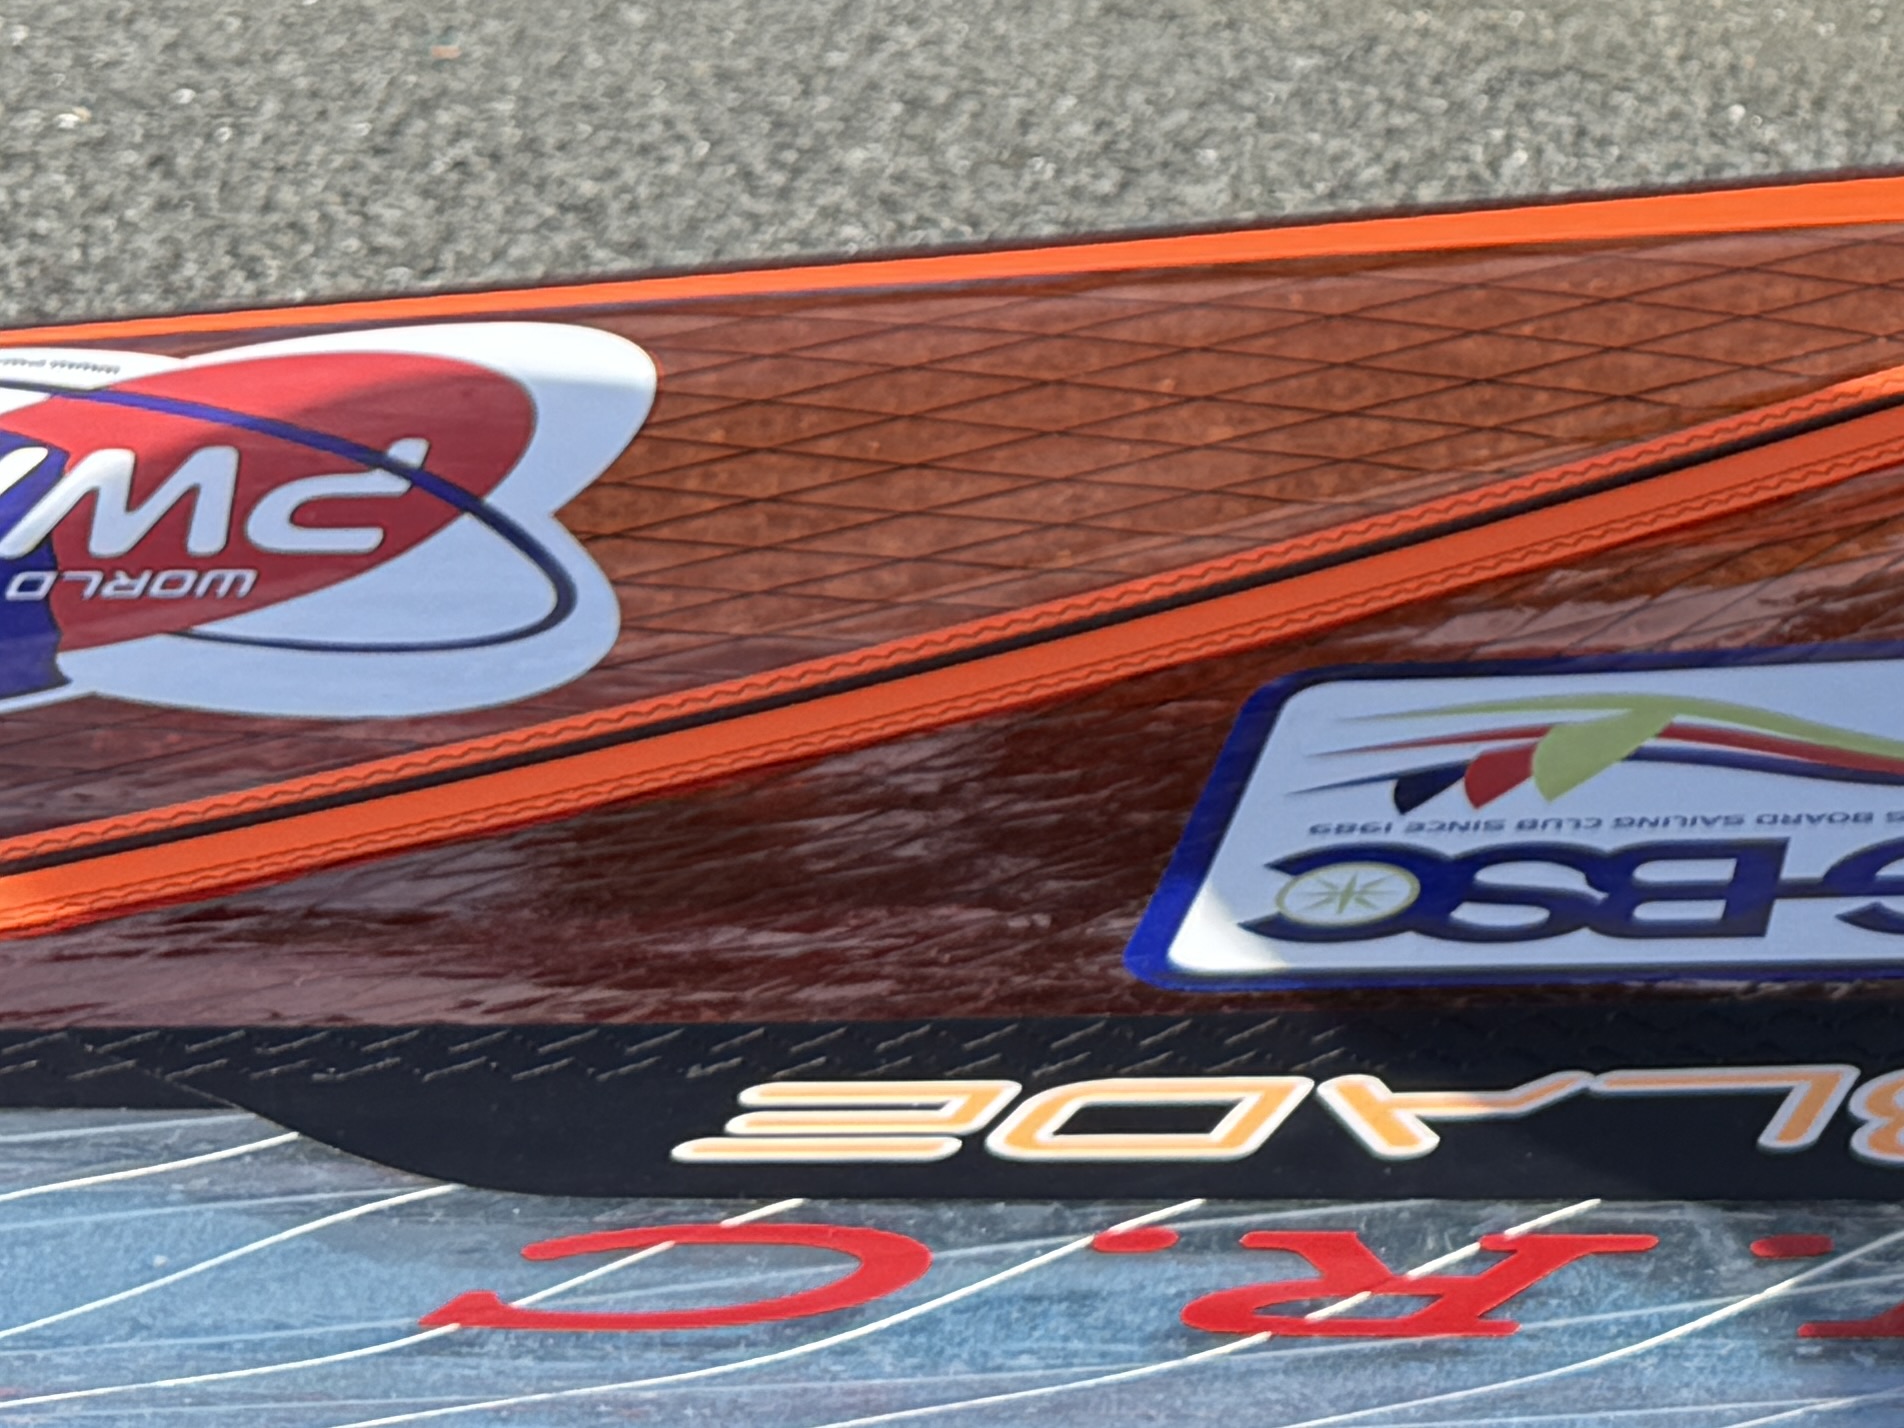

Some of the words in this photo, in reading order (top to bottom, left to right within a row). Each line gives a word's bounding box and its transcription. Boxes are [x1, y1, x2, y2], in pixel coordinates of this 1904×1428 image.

[0, 438, 430, 559] PW
[5, 569, 258, 600] WORLD
[1404, 818, 1506, 834] SINCE
[1515, 817, 1603, 832] CLUB
[1611, 813, 1745, 830] SAILING
[1756, 811, 1875, 826] BOARD
[1308, 820, 1393, 836] 1989
